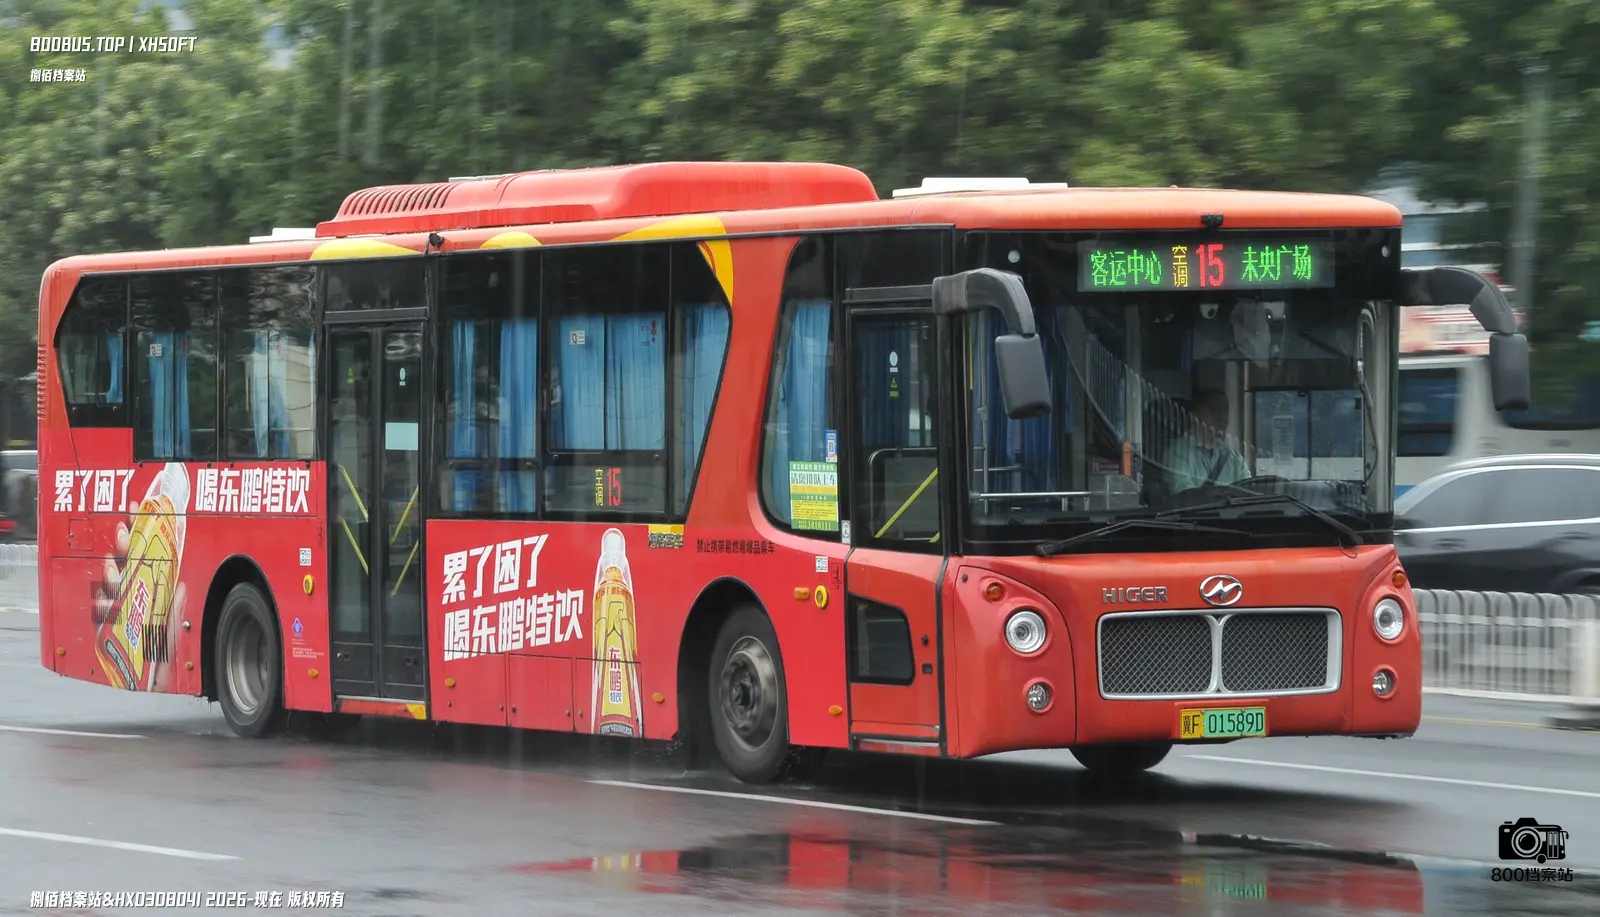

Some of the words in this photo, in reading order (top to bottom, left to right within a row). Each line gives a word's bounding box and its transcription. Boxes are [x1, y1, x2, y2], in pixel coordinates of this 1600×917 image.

[1090, 249, 1163, 286] 客运中心
[1171, 245, 1189, 287] 空调
[1196, 244, 1224, 287] 15
[1241, 244, 1313, 282] 未央广场
[54, 468, 136, 512] 累了困了
[195, 466, 311, 513] 喝东鹏特饮
[606, 467, 622, 506] 15
[441, 533, 549, 605] 累了困了
[1101, 585, 1169, 604] HIGER
[443, 587, 584, 662] 喝东鹏特饮
[1208, 712, 1264, 734] 01589D
